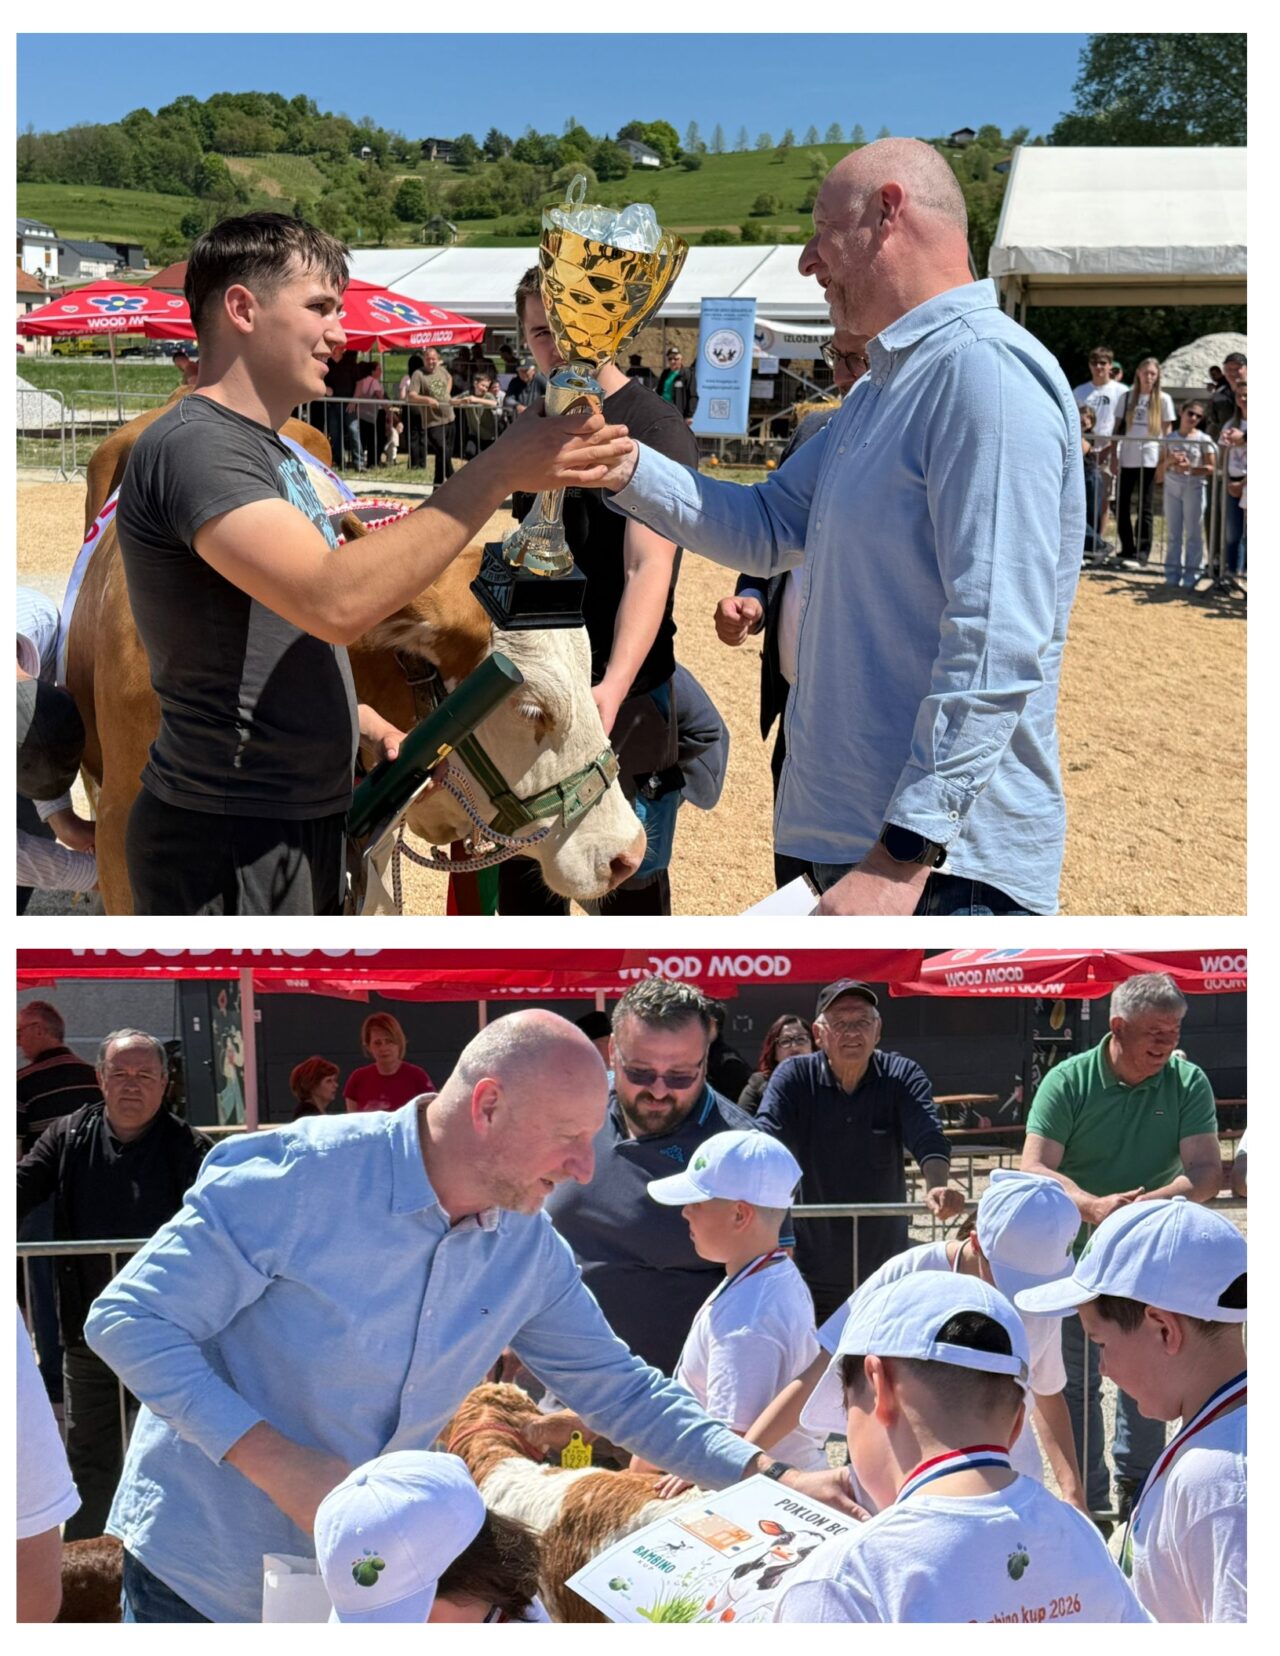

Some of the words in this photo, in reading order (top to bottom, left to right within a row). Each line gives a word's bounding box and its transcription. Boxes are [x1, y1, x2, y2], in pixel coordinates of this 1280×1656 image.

[87, 318, 126, 328] WOOD
[784, 334, 819, 343] IZLOŽBA
[707, 955, 792, 977] MOOD
[944, 970, 983, 987] WOOD
[985, 966, 1024, 983] MOOD
[774, 1498, 830, 1527] POKLON
[632, 1545, 676, 1573] BAMBINO
[1022, 1605, 1046, 1623] kup
[1049, 1594, 1081, 1619] 2026
